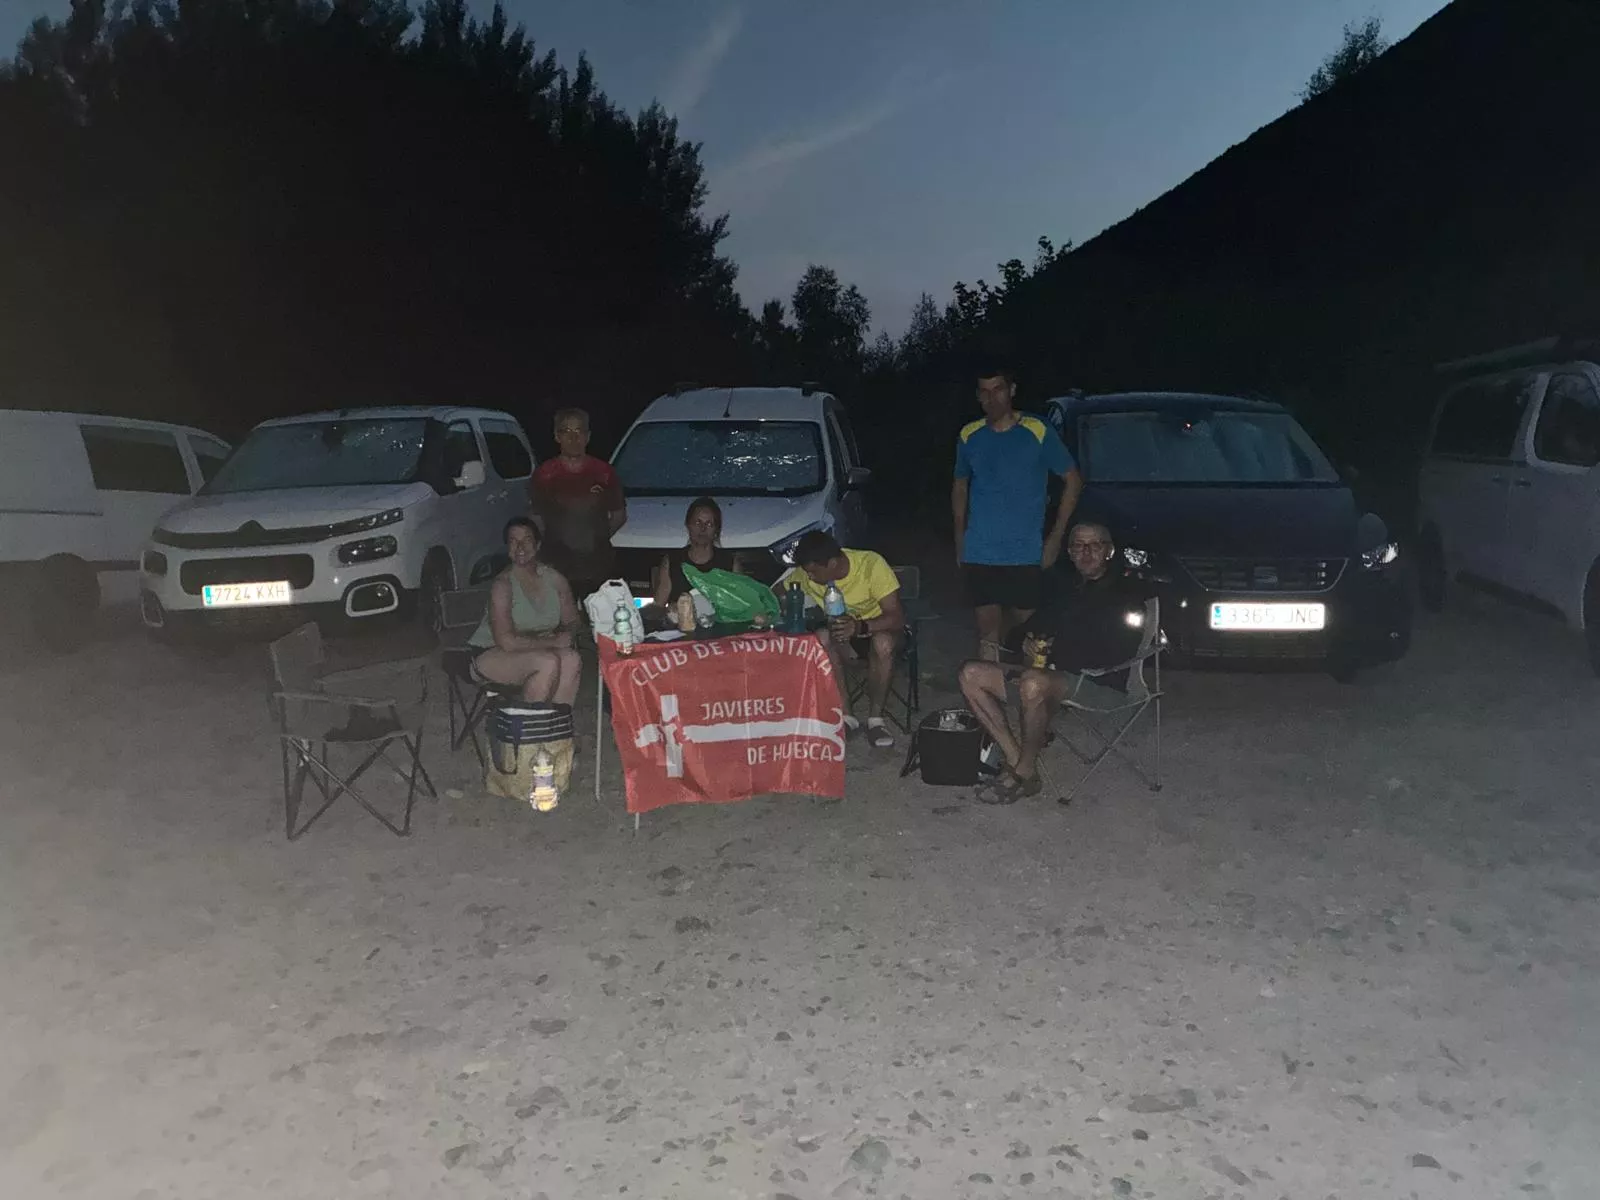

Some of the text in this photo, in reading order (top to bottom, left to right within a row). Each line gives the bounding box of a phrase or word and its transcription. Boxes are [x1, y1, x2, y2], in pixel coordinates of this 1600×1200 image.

[214, 585, 285, 601] 7724 KXH
[631, 636, 832, 687] CLUB DE MONTAÑA
[701, 697, 785, 720] JAVIERES
[747, 741, 832, 765] DE HUESCA
